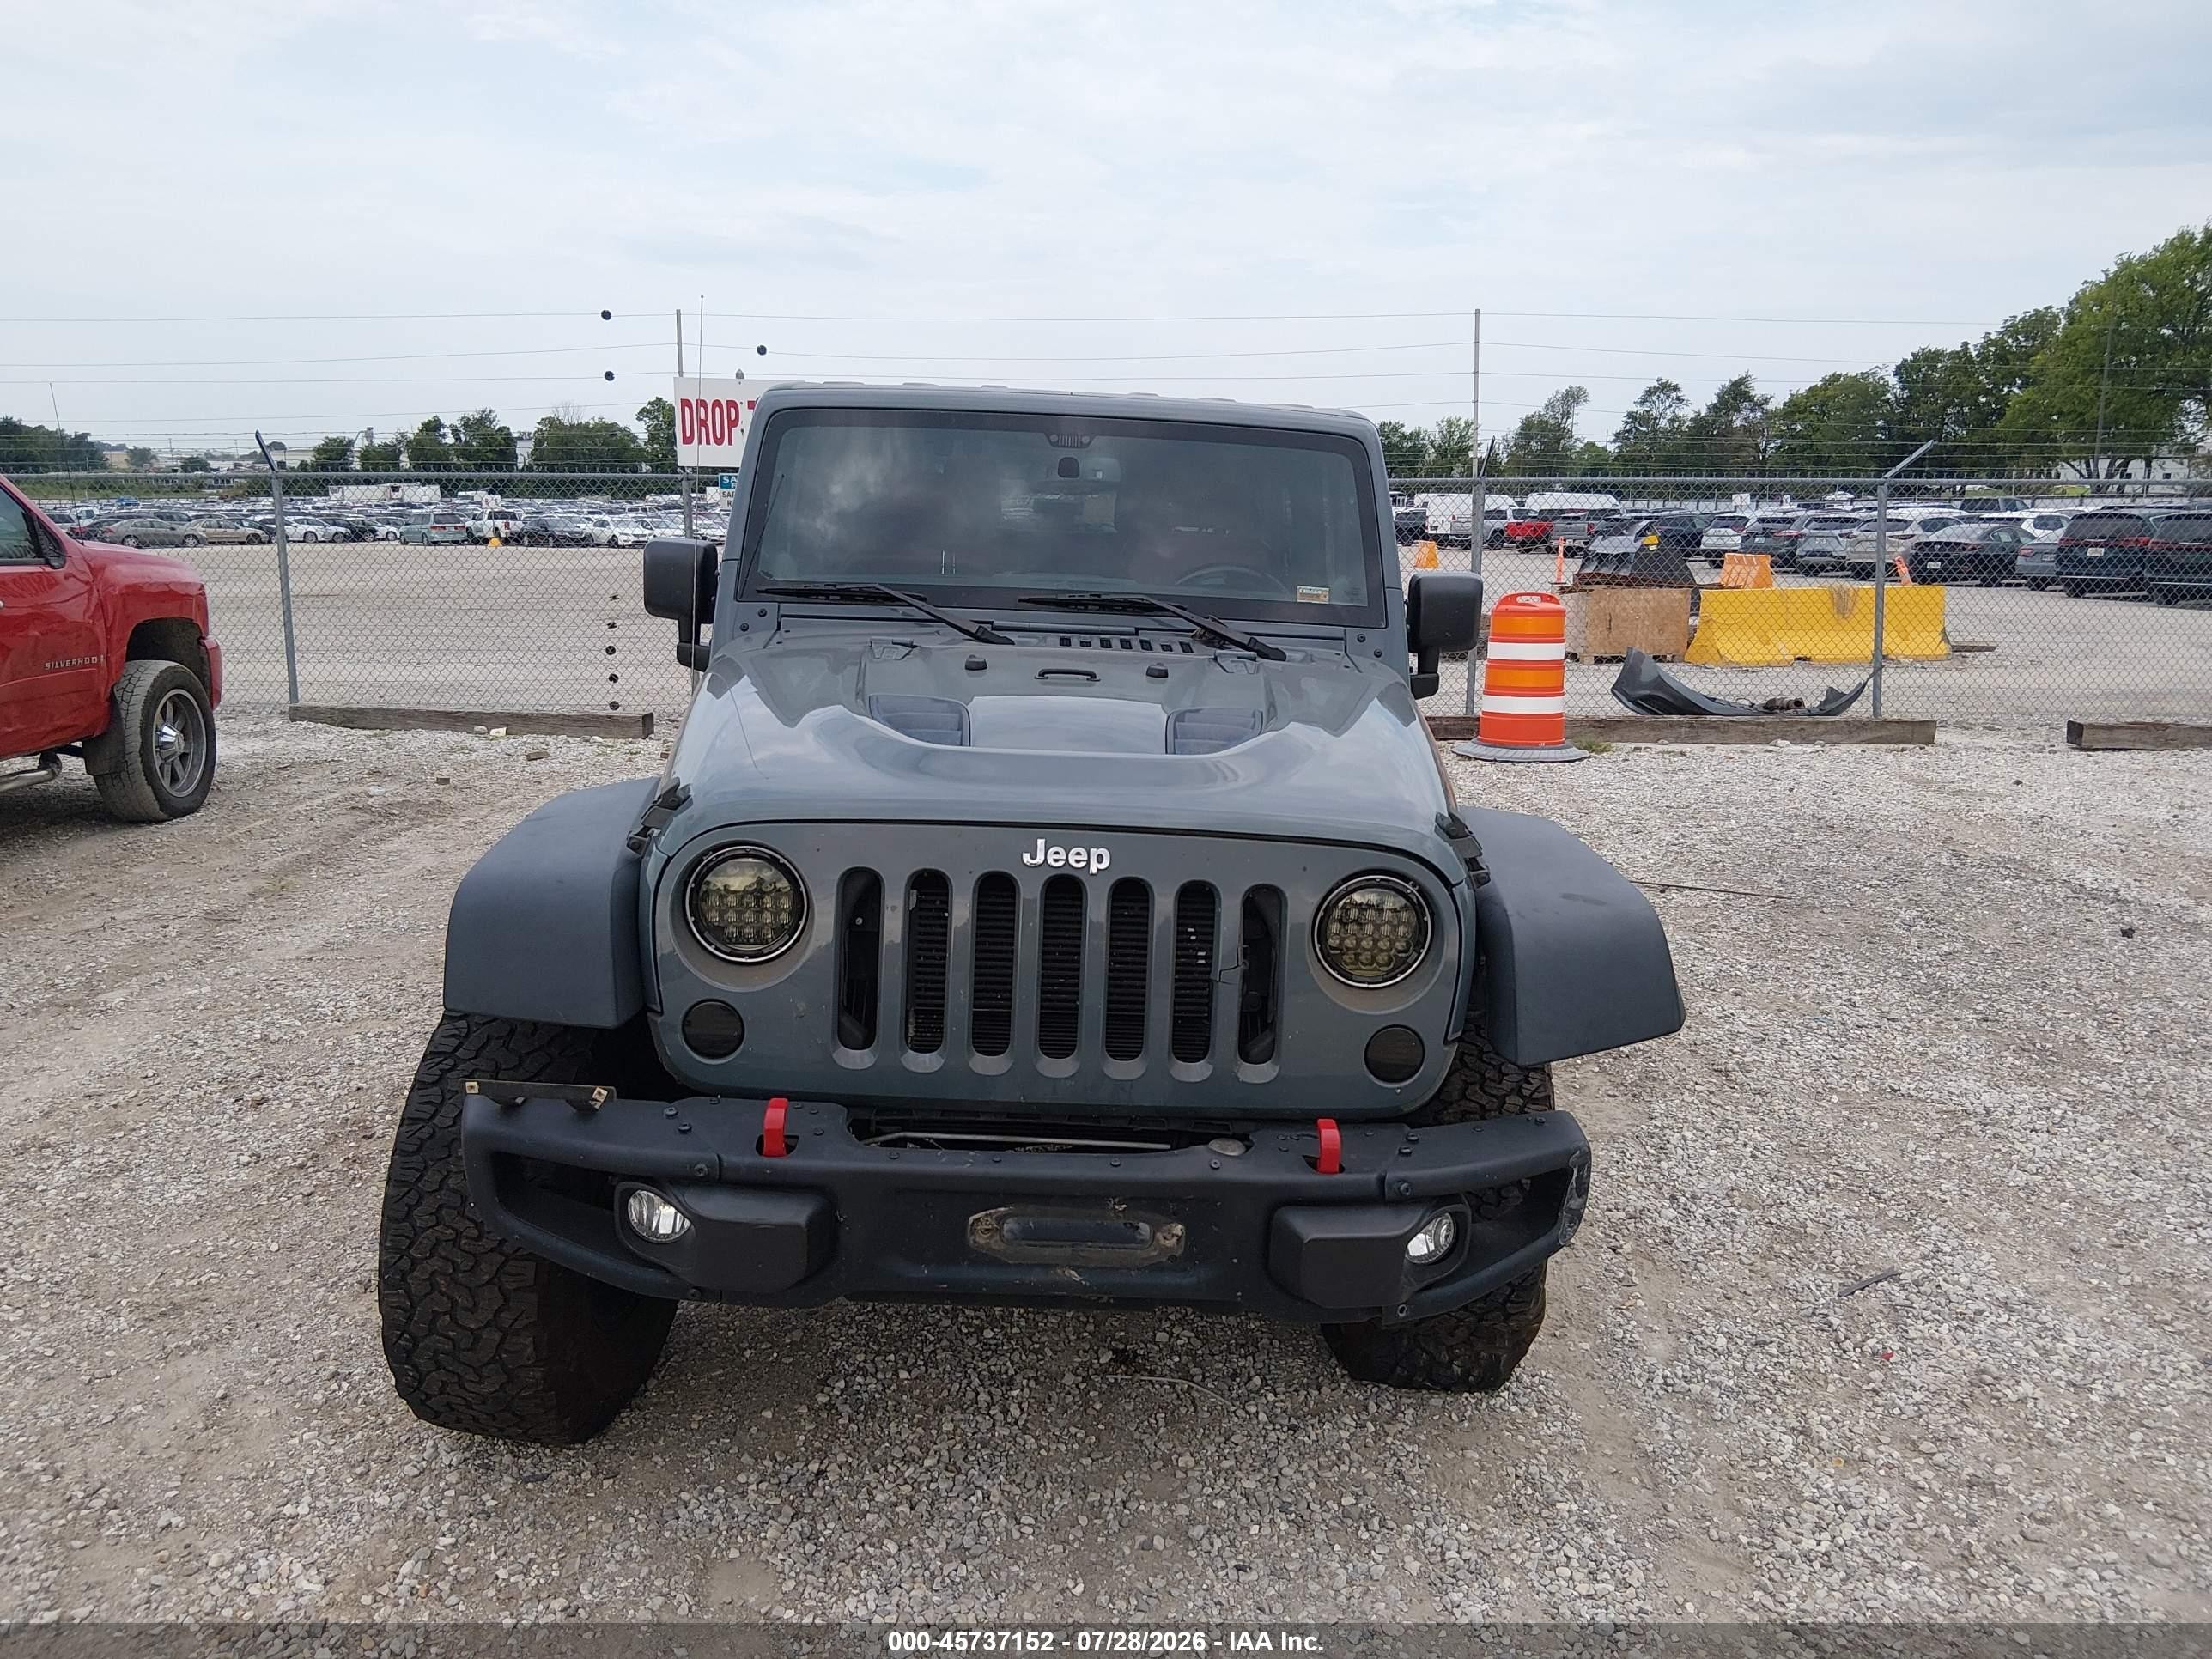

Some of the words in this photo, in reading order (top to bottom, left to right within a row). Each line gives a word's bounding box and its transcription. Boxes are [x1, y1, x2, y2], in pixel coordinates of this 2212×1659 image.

[680, 398, 740, 446] DROP
[44, 656, 98, 671] SILVERADO
[1022, 838, 1110, 874] Jeep
